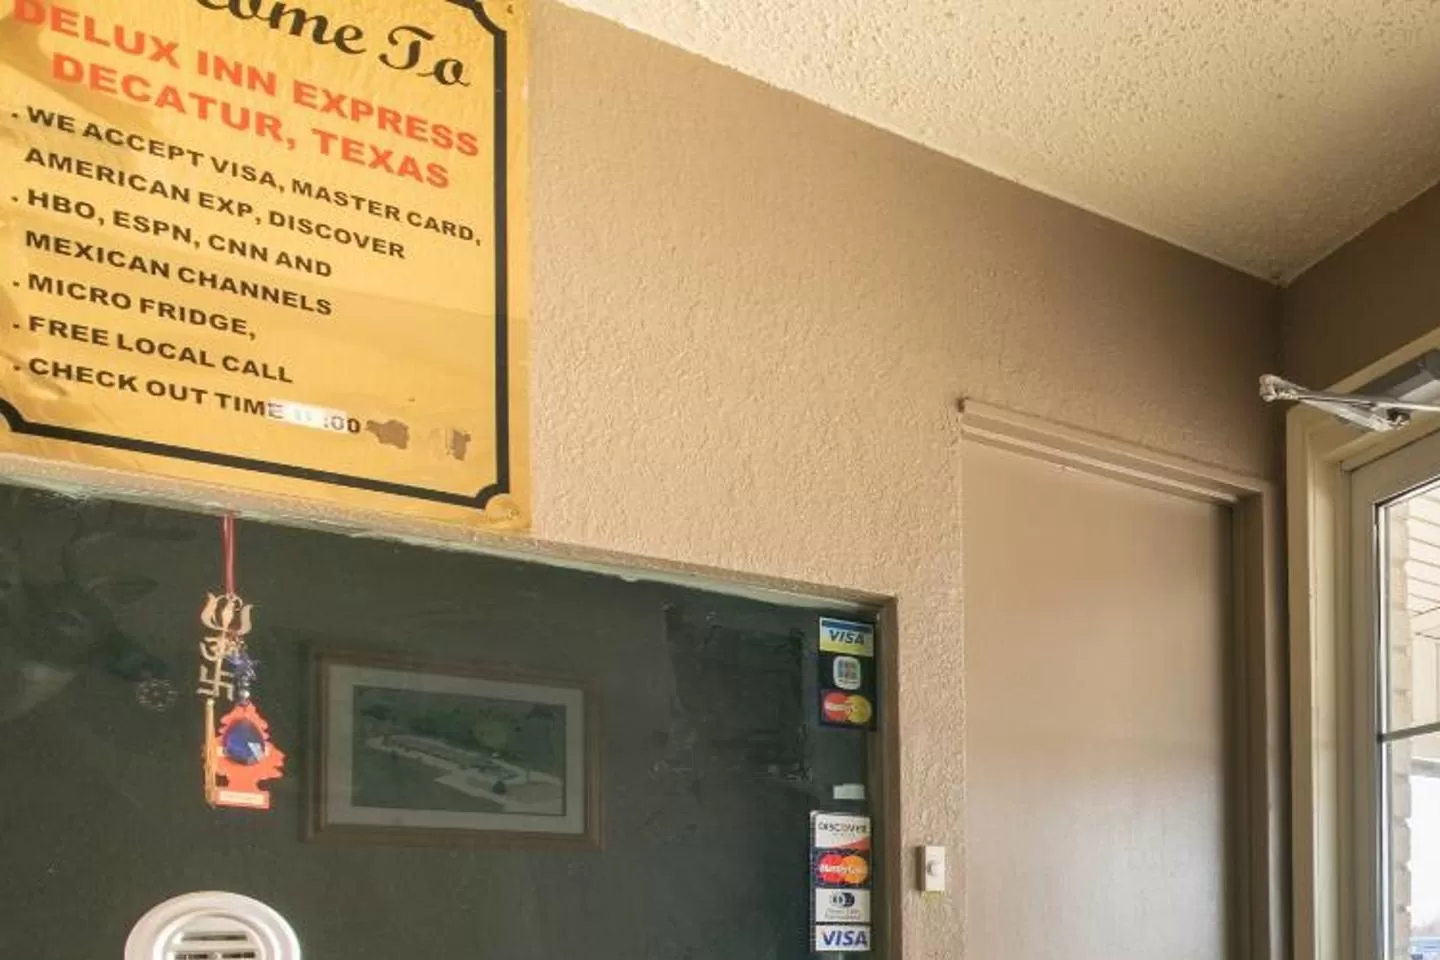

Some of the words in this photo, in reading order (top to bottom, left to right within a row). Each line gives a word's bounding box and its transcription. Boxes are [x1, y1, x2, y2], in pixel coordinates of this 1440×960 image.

[14, 0, 181, 69] DELUX
[197, 50, 277, 97] INN
[293, 79, 479, 157] EXPRESS
[197, 0, 366, 54] ome
[379, 26, 471, 87] To
[53, 52, 296, 150] DECATUR,
[312, 128, 449, 188] TEXAS
[24, 148, 190, 203] AMERICAN
[198, 192, 262, 225] EXP,
[269, 210, 405, 259] DISCOVER
[27, 105, 76, 134] WE
[82, 123, 204, 167] ACCEPT
[210, 156, 285, 194] VISA,
[292, 178, 401, 222] MASTER
[406, 211, 481, 246] CARD,
[25, 230, 170, 279] MEXICAN
[178, 266, 332, 316] CHANNELS
[28, 189, 105, 226] HBO,
[112, 210, 200, 248] ESPN,
[208, 235, 268, 262] CNN
[275, 251, 332, 277] AND
[28, 273, 131, 310] MICRO
[140, 297, 256, 340] FRIDGE,
[29, 315, 109, 346] FREE
[117, 333, 216, 368] LOCAL
[221, 355, 293, 383] CALL
[28, 358, 138, 393] CHECK
[146, 379, 208, 405] OUT
[213, 392, 284, 419] TIME
[829, 628, 865, 646] VISA
[822, 930, 868, 947] VISA
